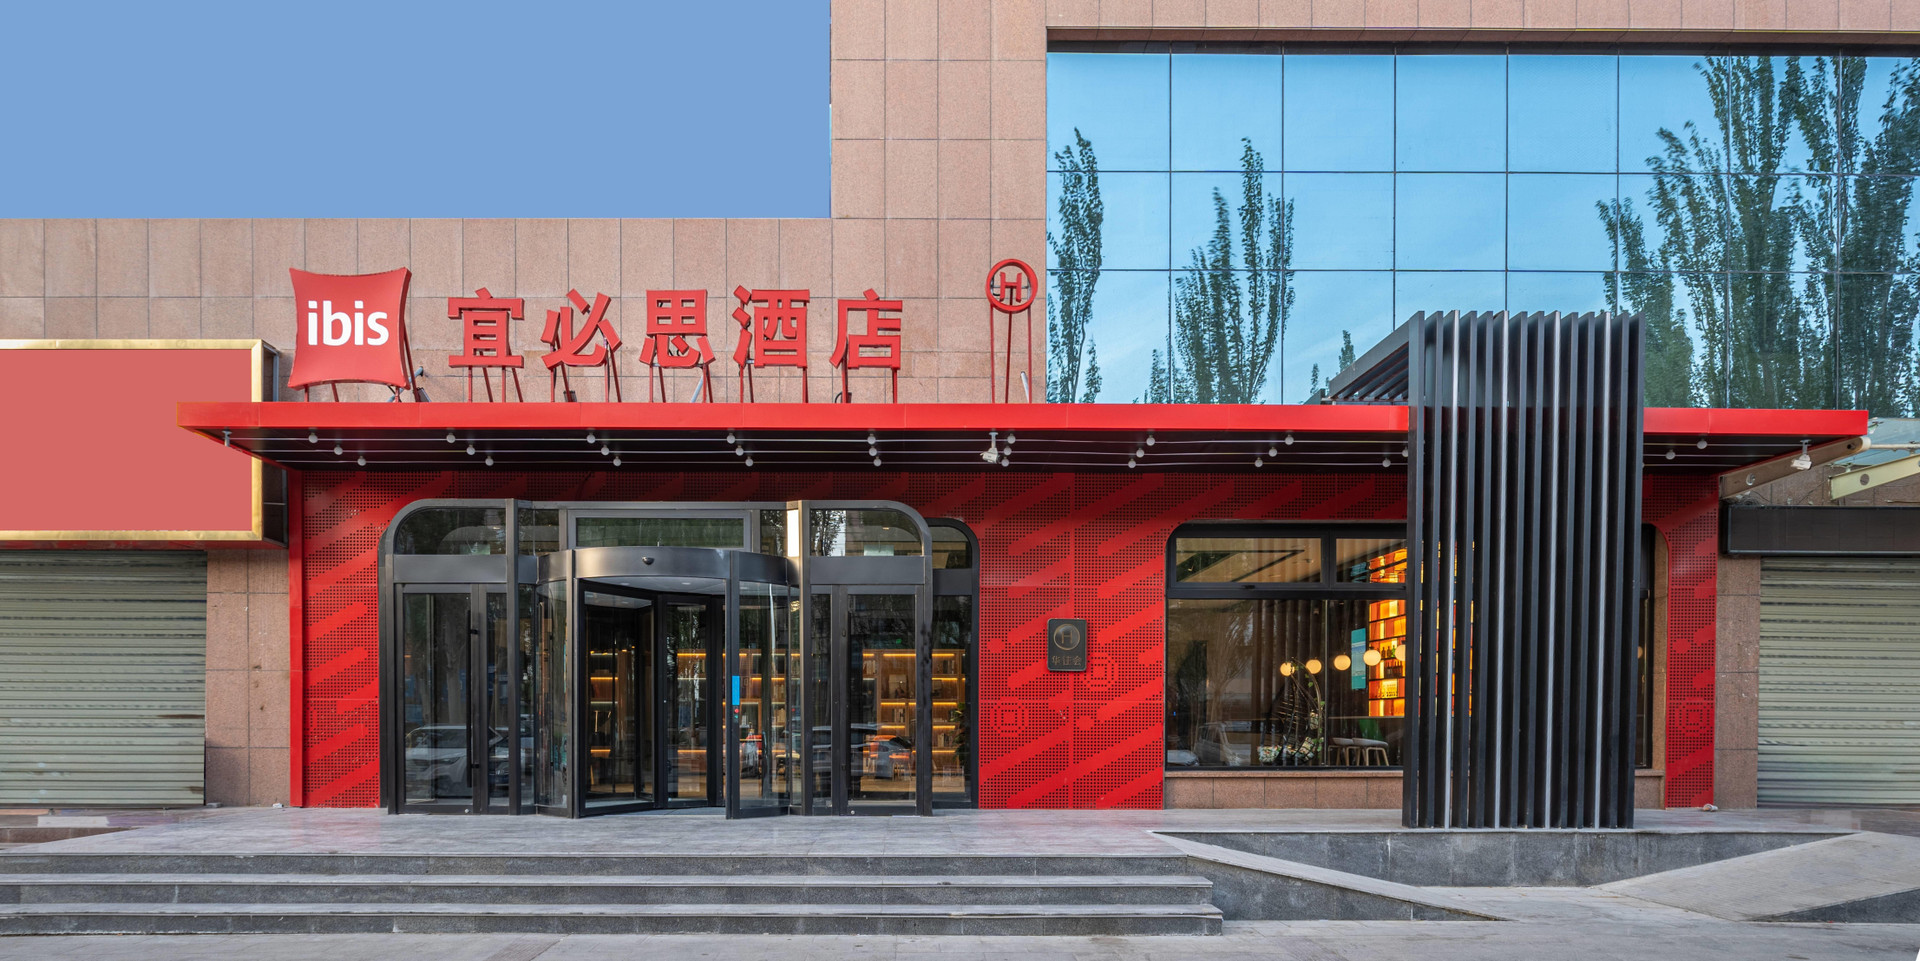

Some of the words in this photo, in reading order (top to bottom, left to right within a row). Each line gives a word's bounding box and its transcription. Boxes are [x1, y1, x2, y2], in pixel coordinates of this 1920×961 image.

[1000, 271, 1022, 303] H
[307, 300, 389, 346] ibis
[448, 287, 904, 368] 宜必思酒店
